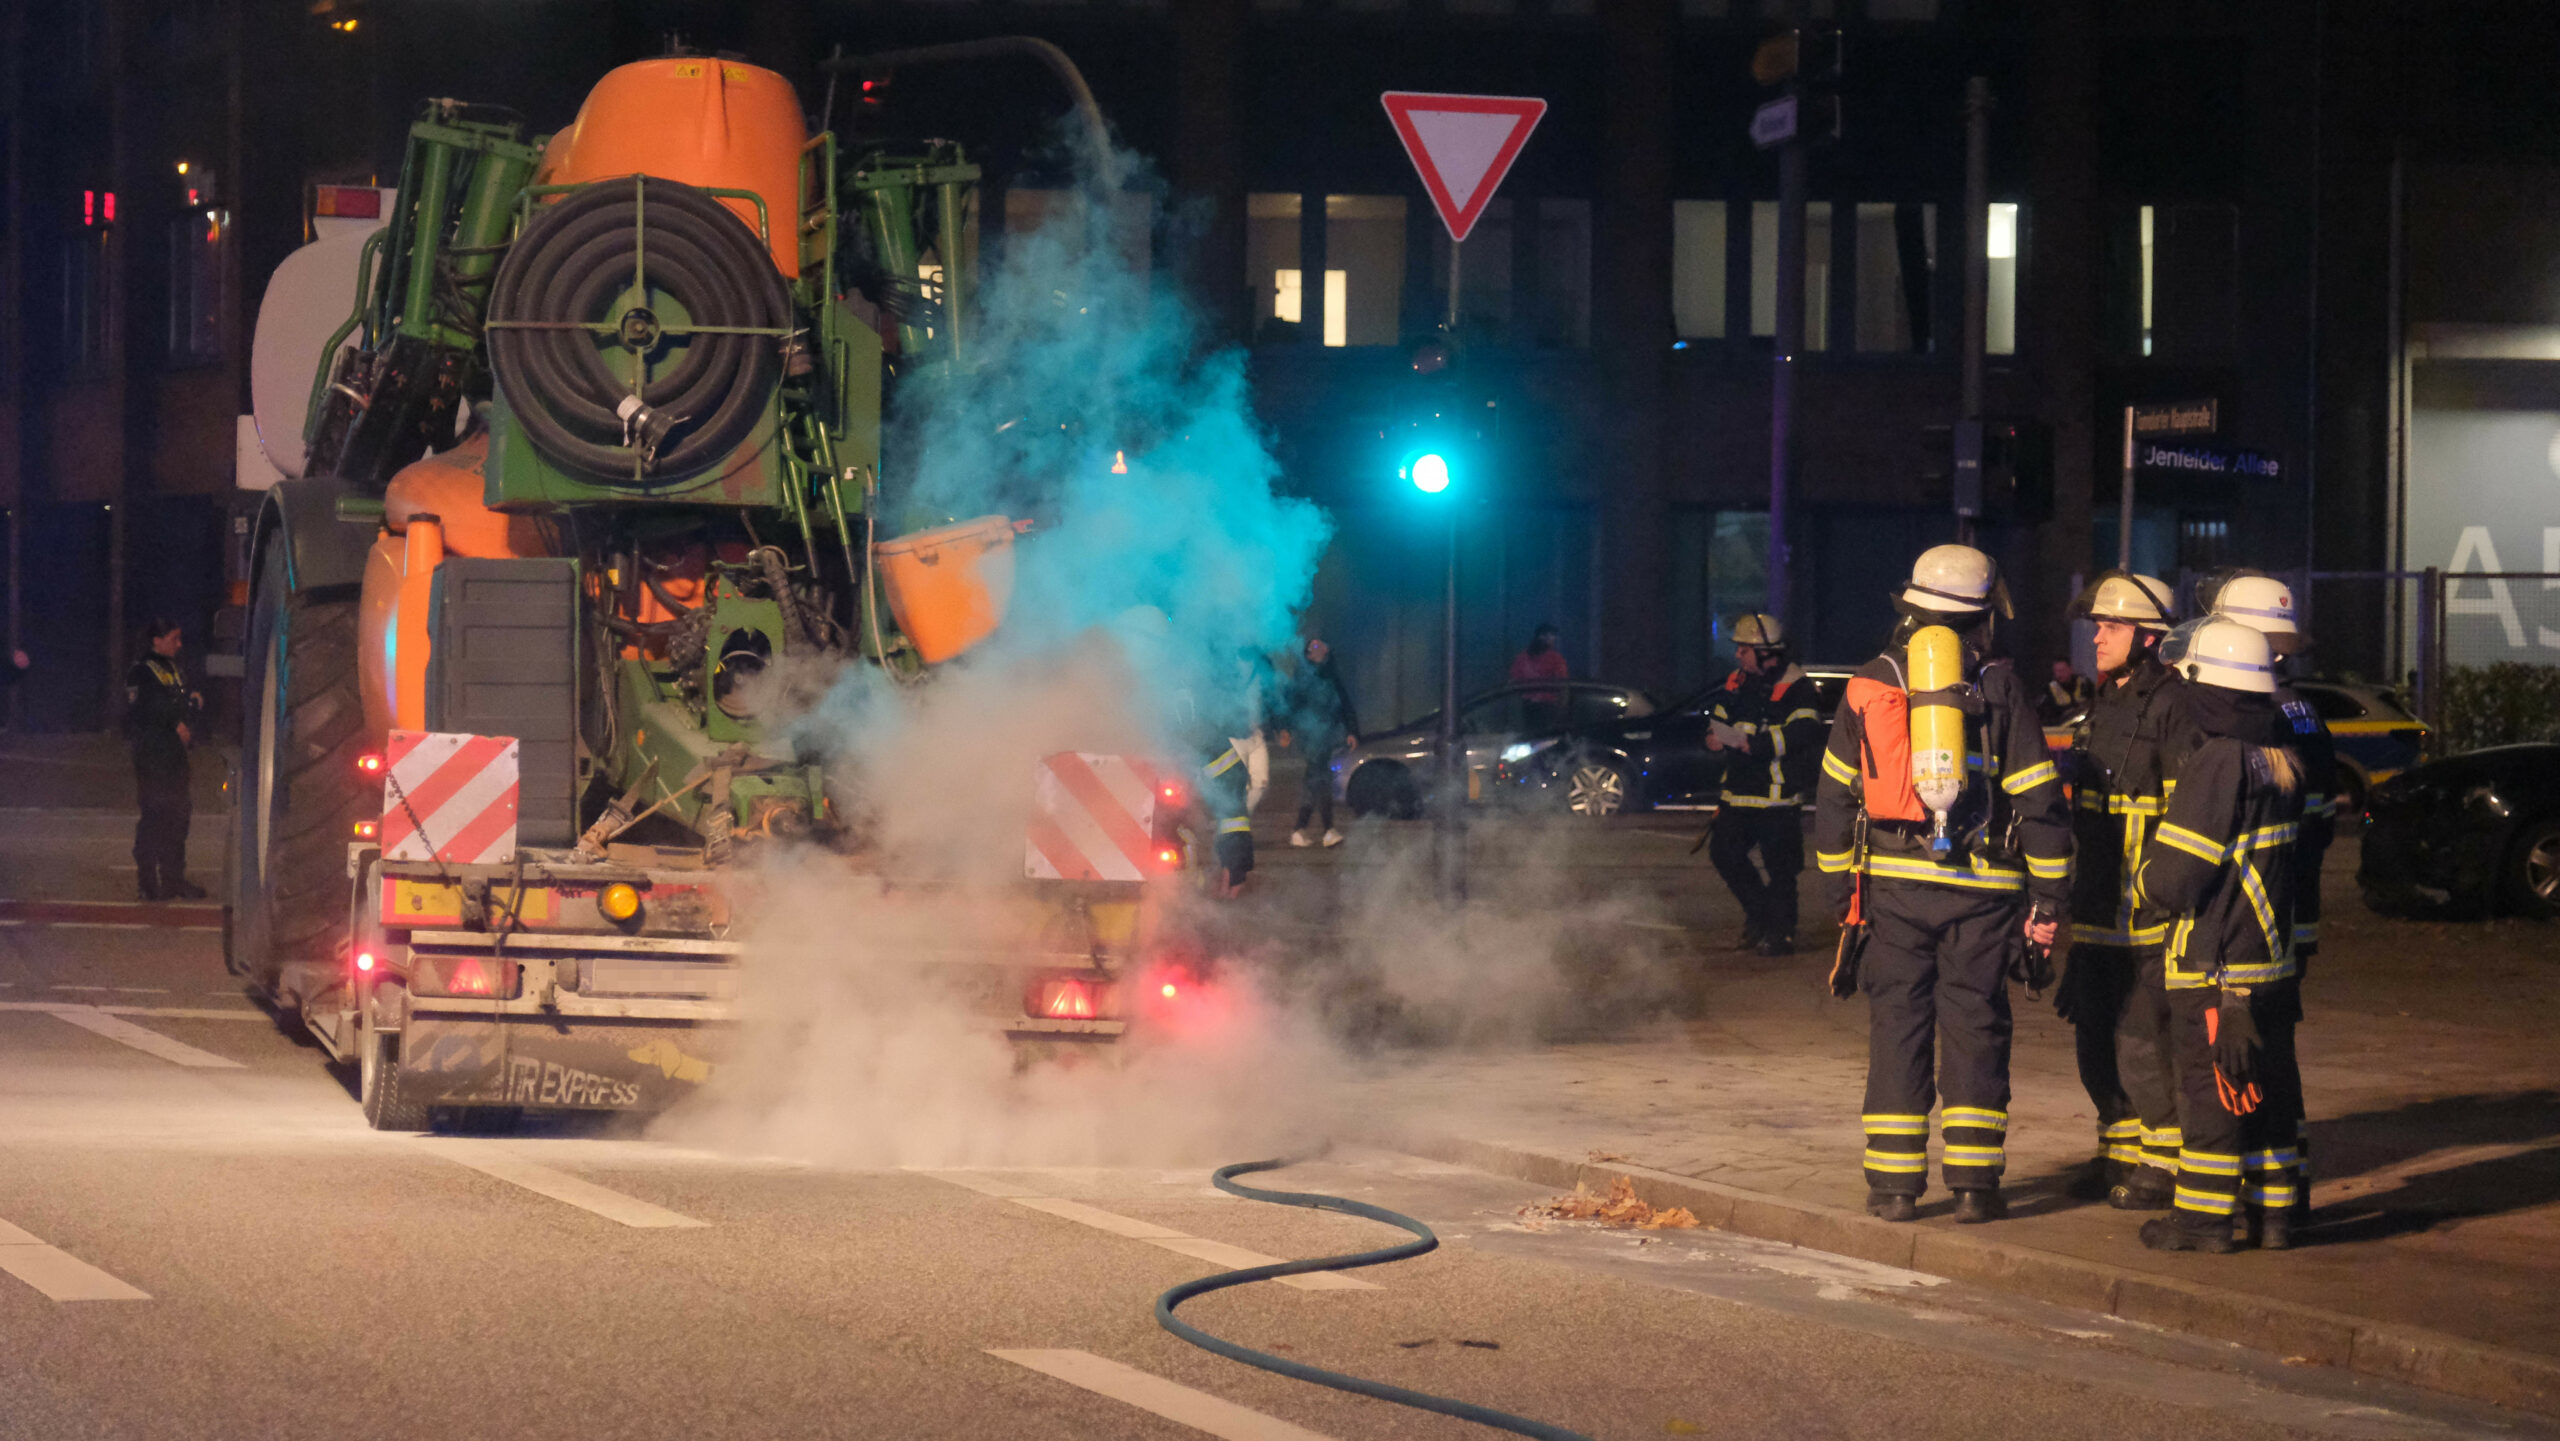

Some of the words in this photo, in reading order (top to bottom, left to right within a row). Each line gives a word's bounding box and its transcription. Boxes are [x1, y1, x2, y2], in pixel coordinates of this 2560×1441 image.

[2145, 446, 2227, 472] Jenfelder
[2233, 453, 2279, 476] Allee
[540, 1063, 640, 1105] EXPRESS
